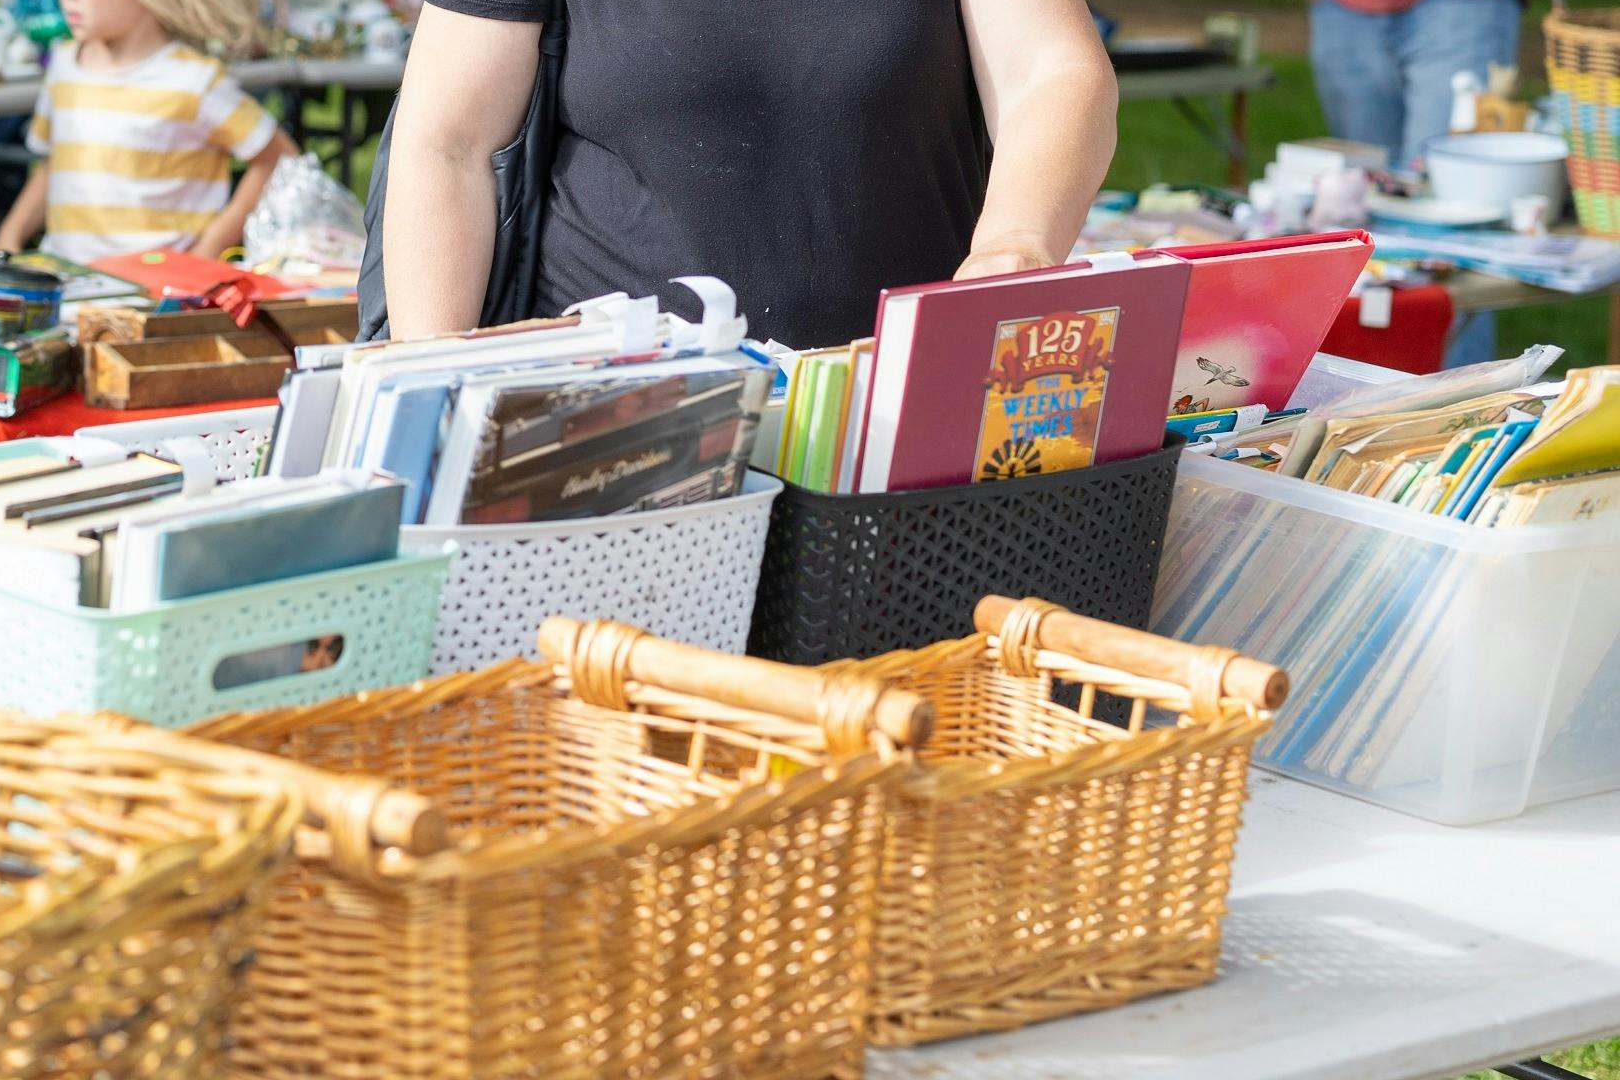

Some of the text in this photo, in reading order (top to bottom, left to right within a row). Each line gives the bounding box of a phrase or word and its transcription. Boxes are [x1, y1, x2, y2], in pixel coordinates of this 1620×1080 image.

[1026, 319, 1086, 358] 125
[1022, 354, 1079, 370] YEARS
[1004, 387, 1089, 416] WEEKLY
[1010, 413, 1074, 444] TIMES
